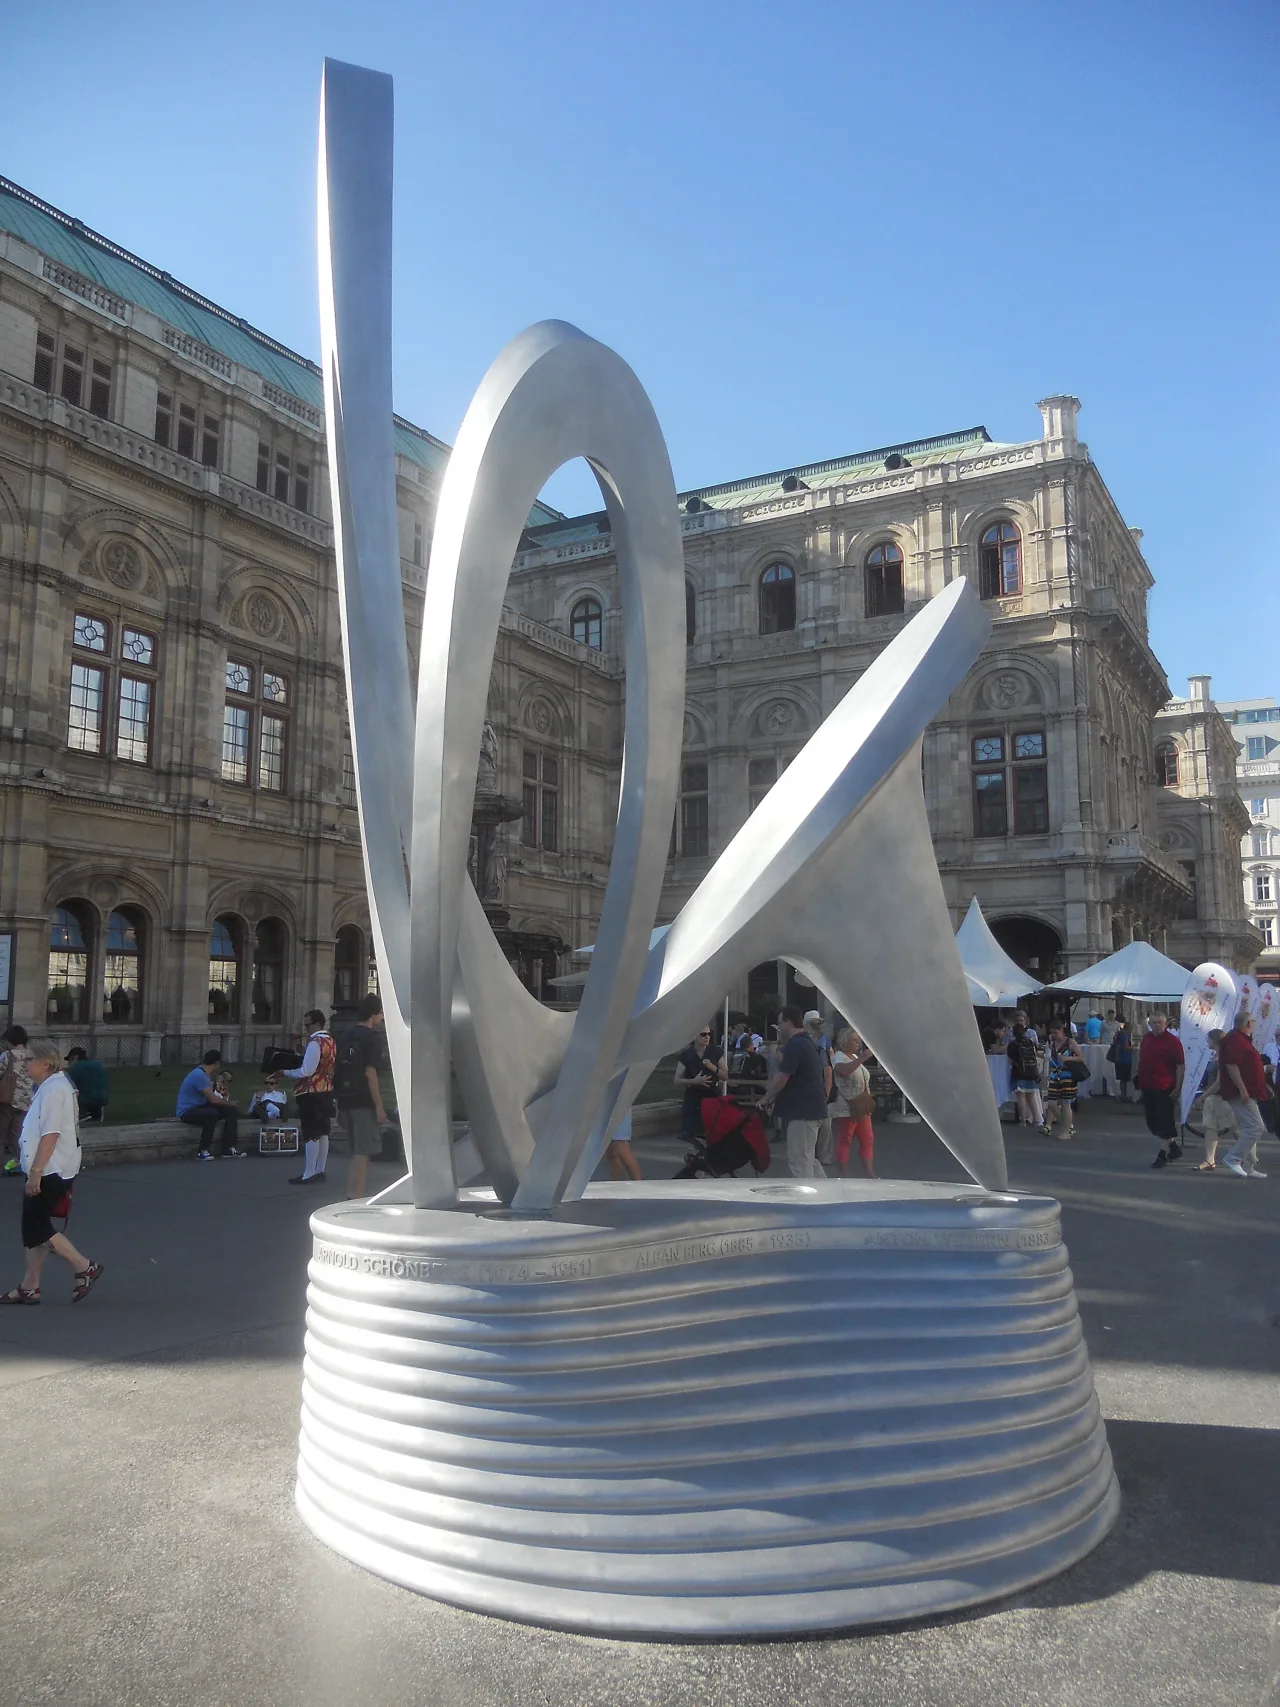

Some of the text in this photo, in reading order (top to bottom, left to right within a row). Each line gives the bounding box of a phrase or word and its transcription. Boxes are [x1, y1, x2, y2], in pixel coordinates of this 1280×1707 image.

[864, 1232, 928, 1247] ANTON
[934, 1231, 1010, 1248] WEBERN
[318, 1247, 359, 1271] ARNOLD
[363, 1255, 470, 1280] SCHÖNBG
[552, 1257, 592, 1277] 1951)
